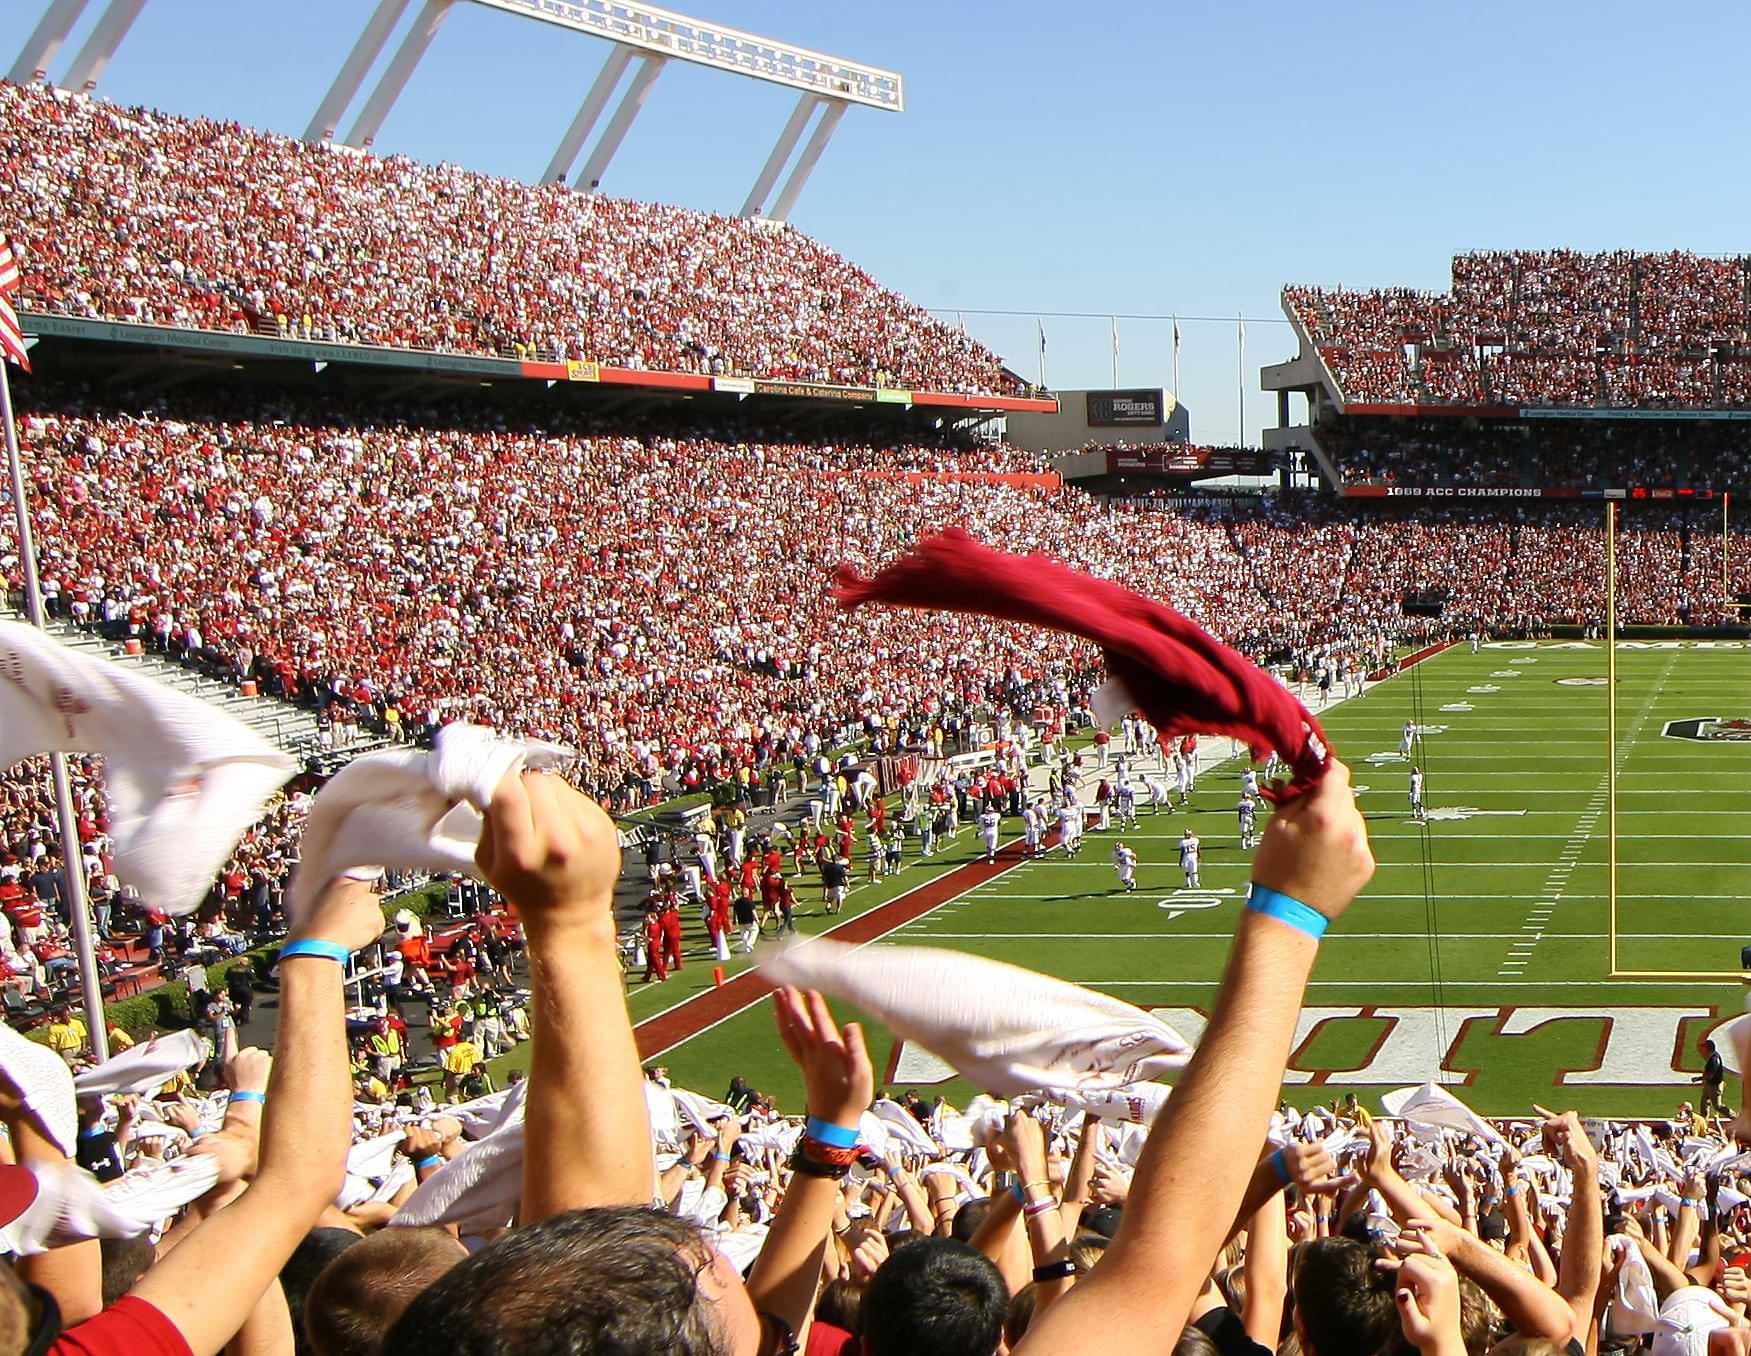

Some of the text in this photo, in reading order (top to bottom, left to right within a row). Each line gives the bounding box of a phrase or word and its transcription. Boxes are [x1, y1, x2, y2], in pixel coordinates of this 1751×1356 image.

[1113, 402, 1155, 411] ROGERS
[1425, 487, 1454, 497] ACC
[1457, 487, 1543, 498] CHAMPIONS
